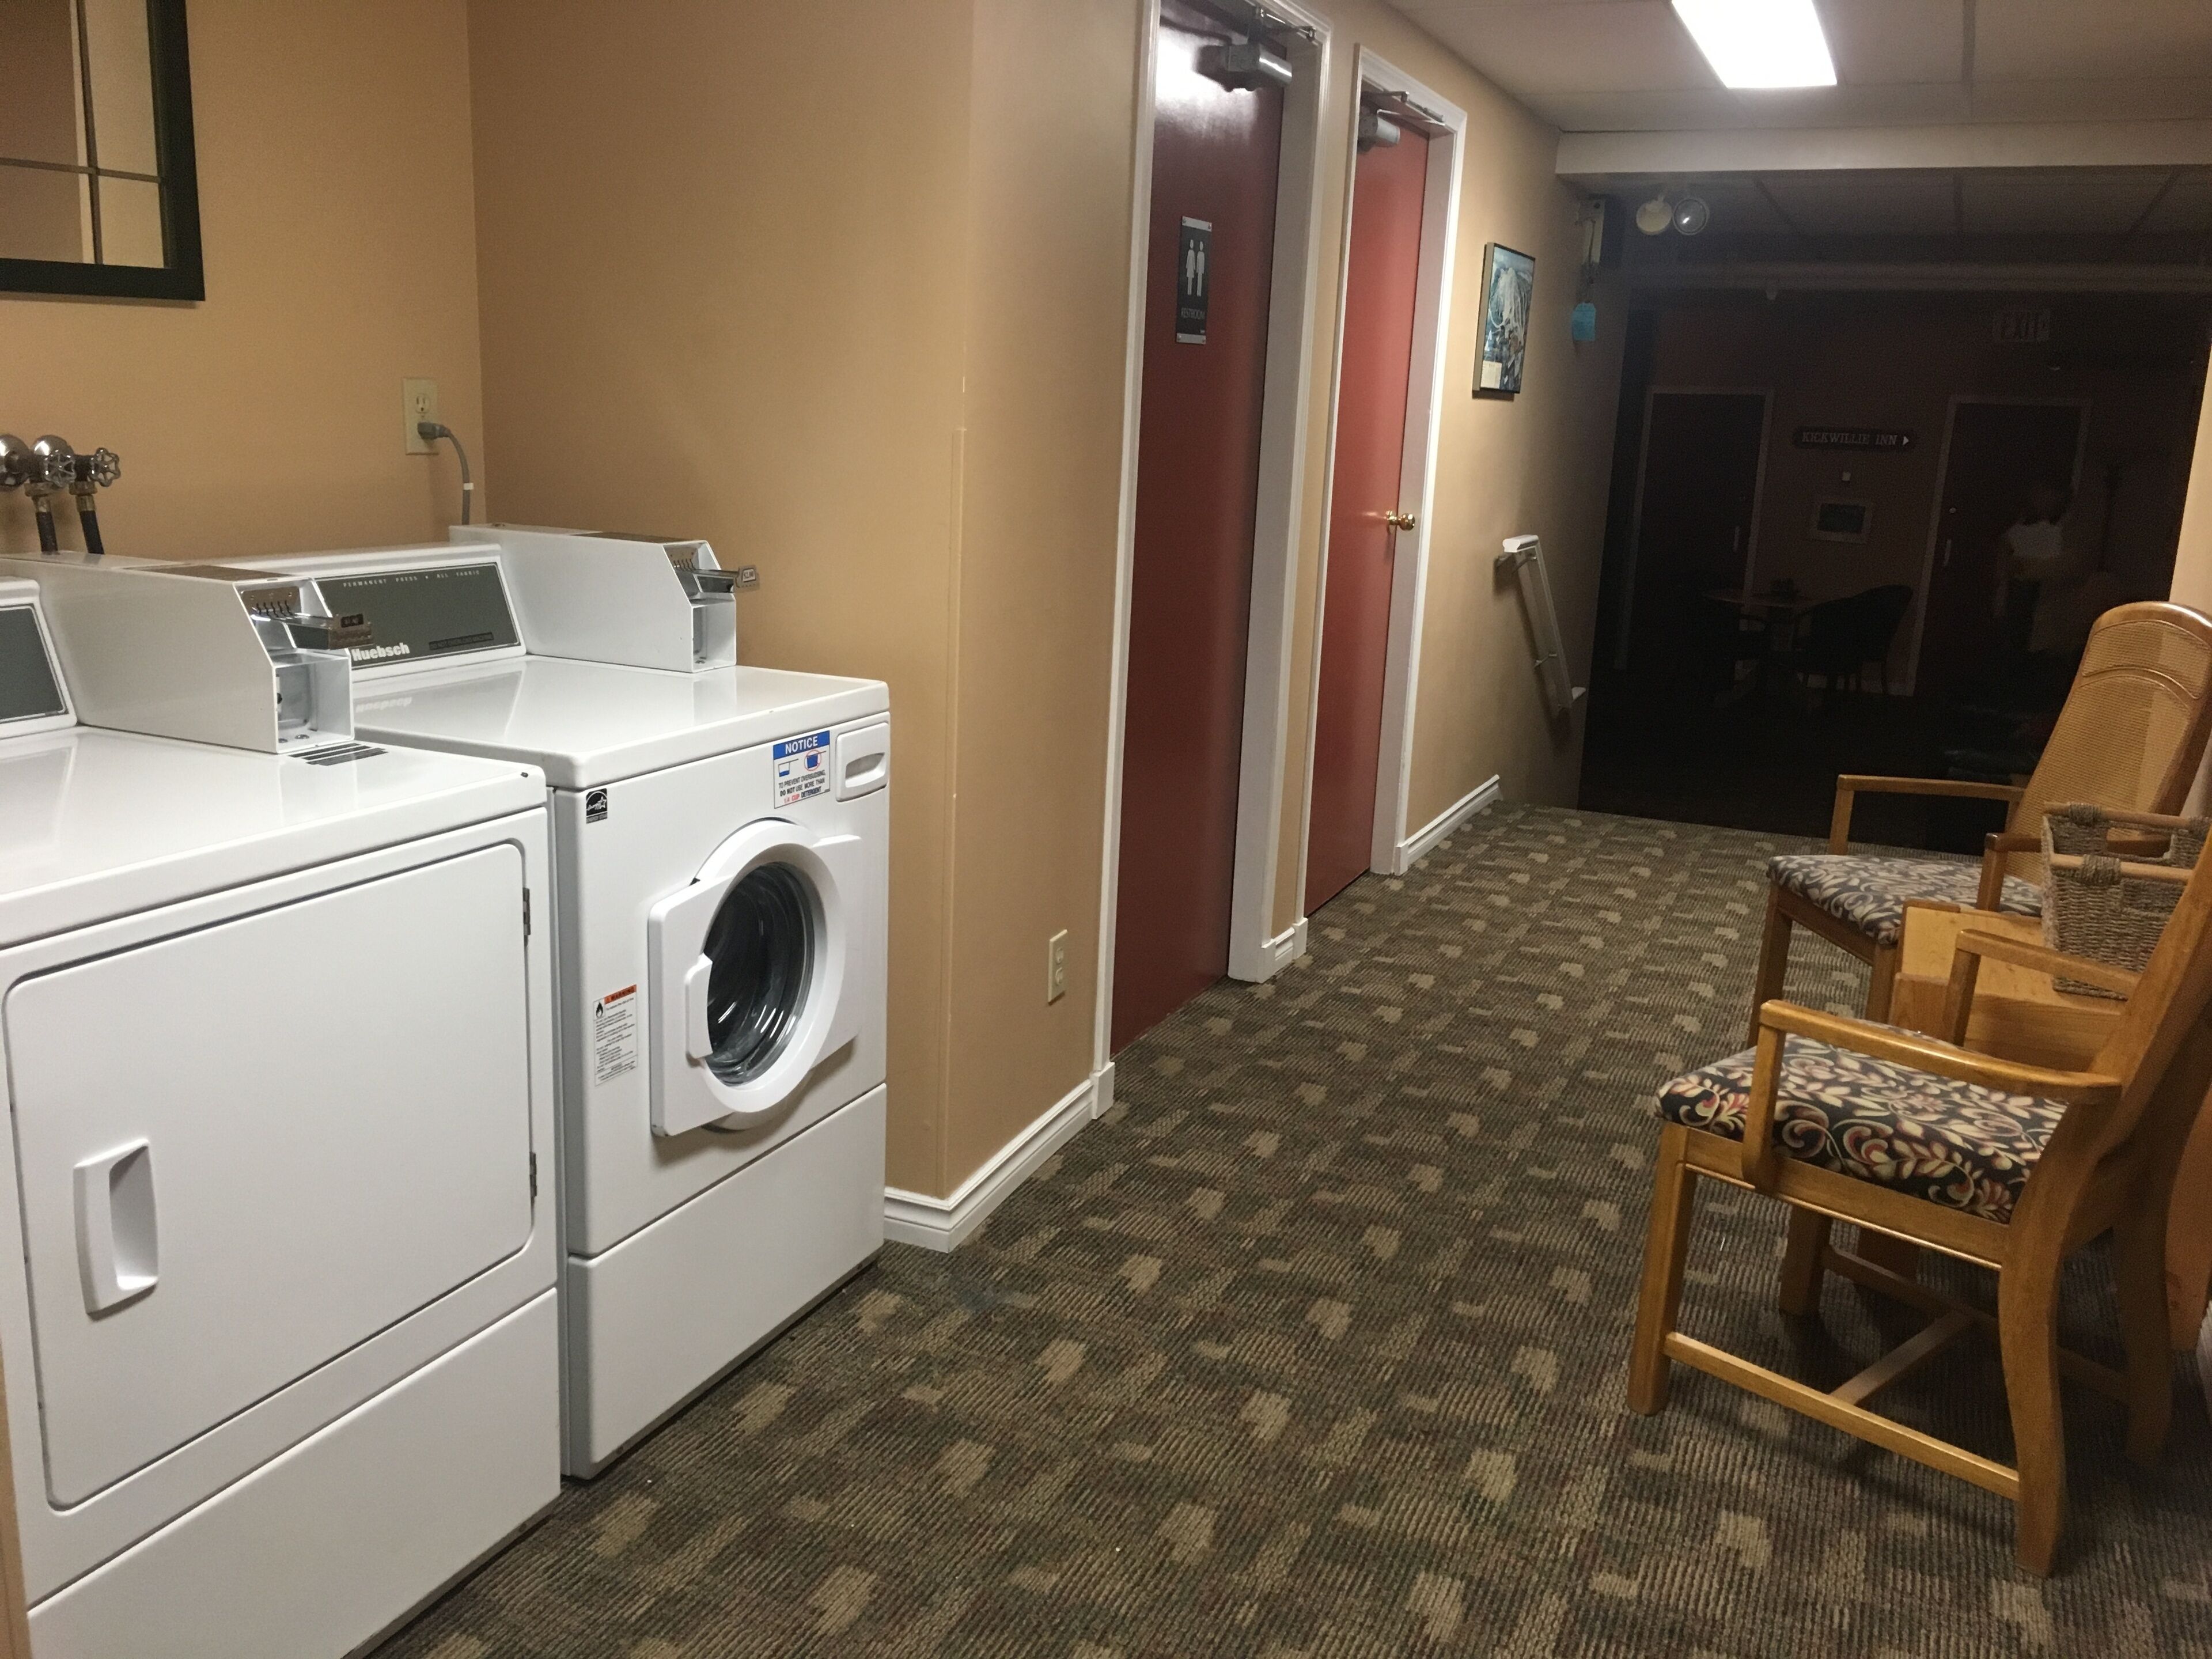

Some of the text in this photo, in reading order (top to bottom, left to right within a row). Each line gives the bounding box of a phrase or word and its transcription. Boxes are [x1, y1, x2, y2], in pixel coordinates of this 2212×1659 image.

[2000, 312, 2036, 339] EXIT
[1802, 432, 1898, 445] KICKWILLIE INN
[343, 578, 387, 588] PERMANENT
[351, 642, 410, 661] Huebsch
[785, 736, 818, 755] NOTICE
[787, 786, 795, 794] NOT
[804, 780, 815, 789] MORE
[816, 777, 825, 785] THAN
